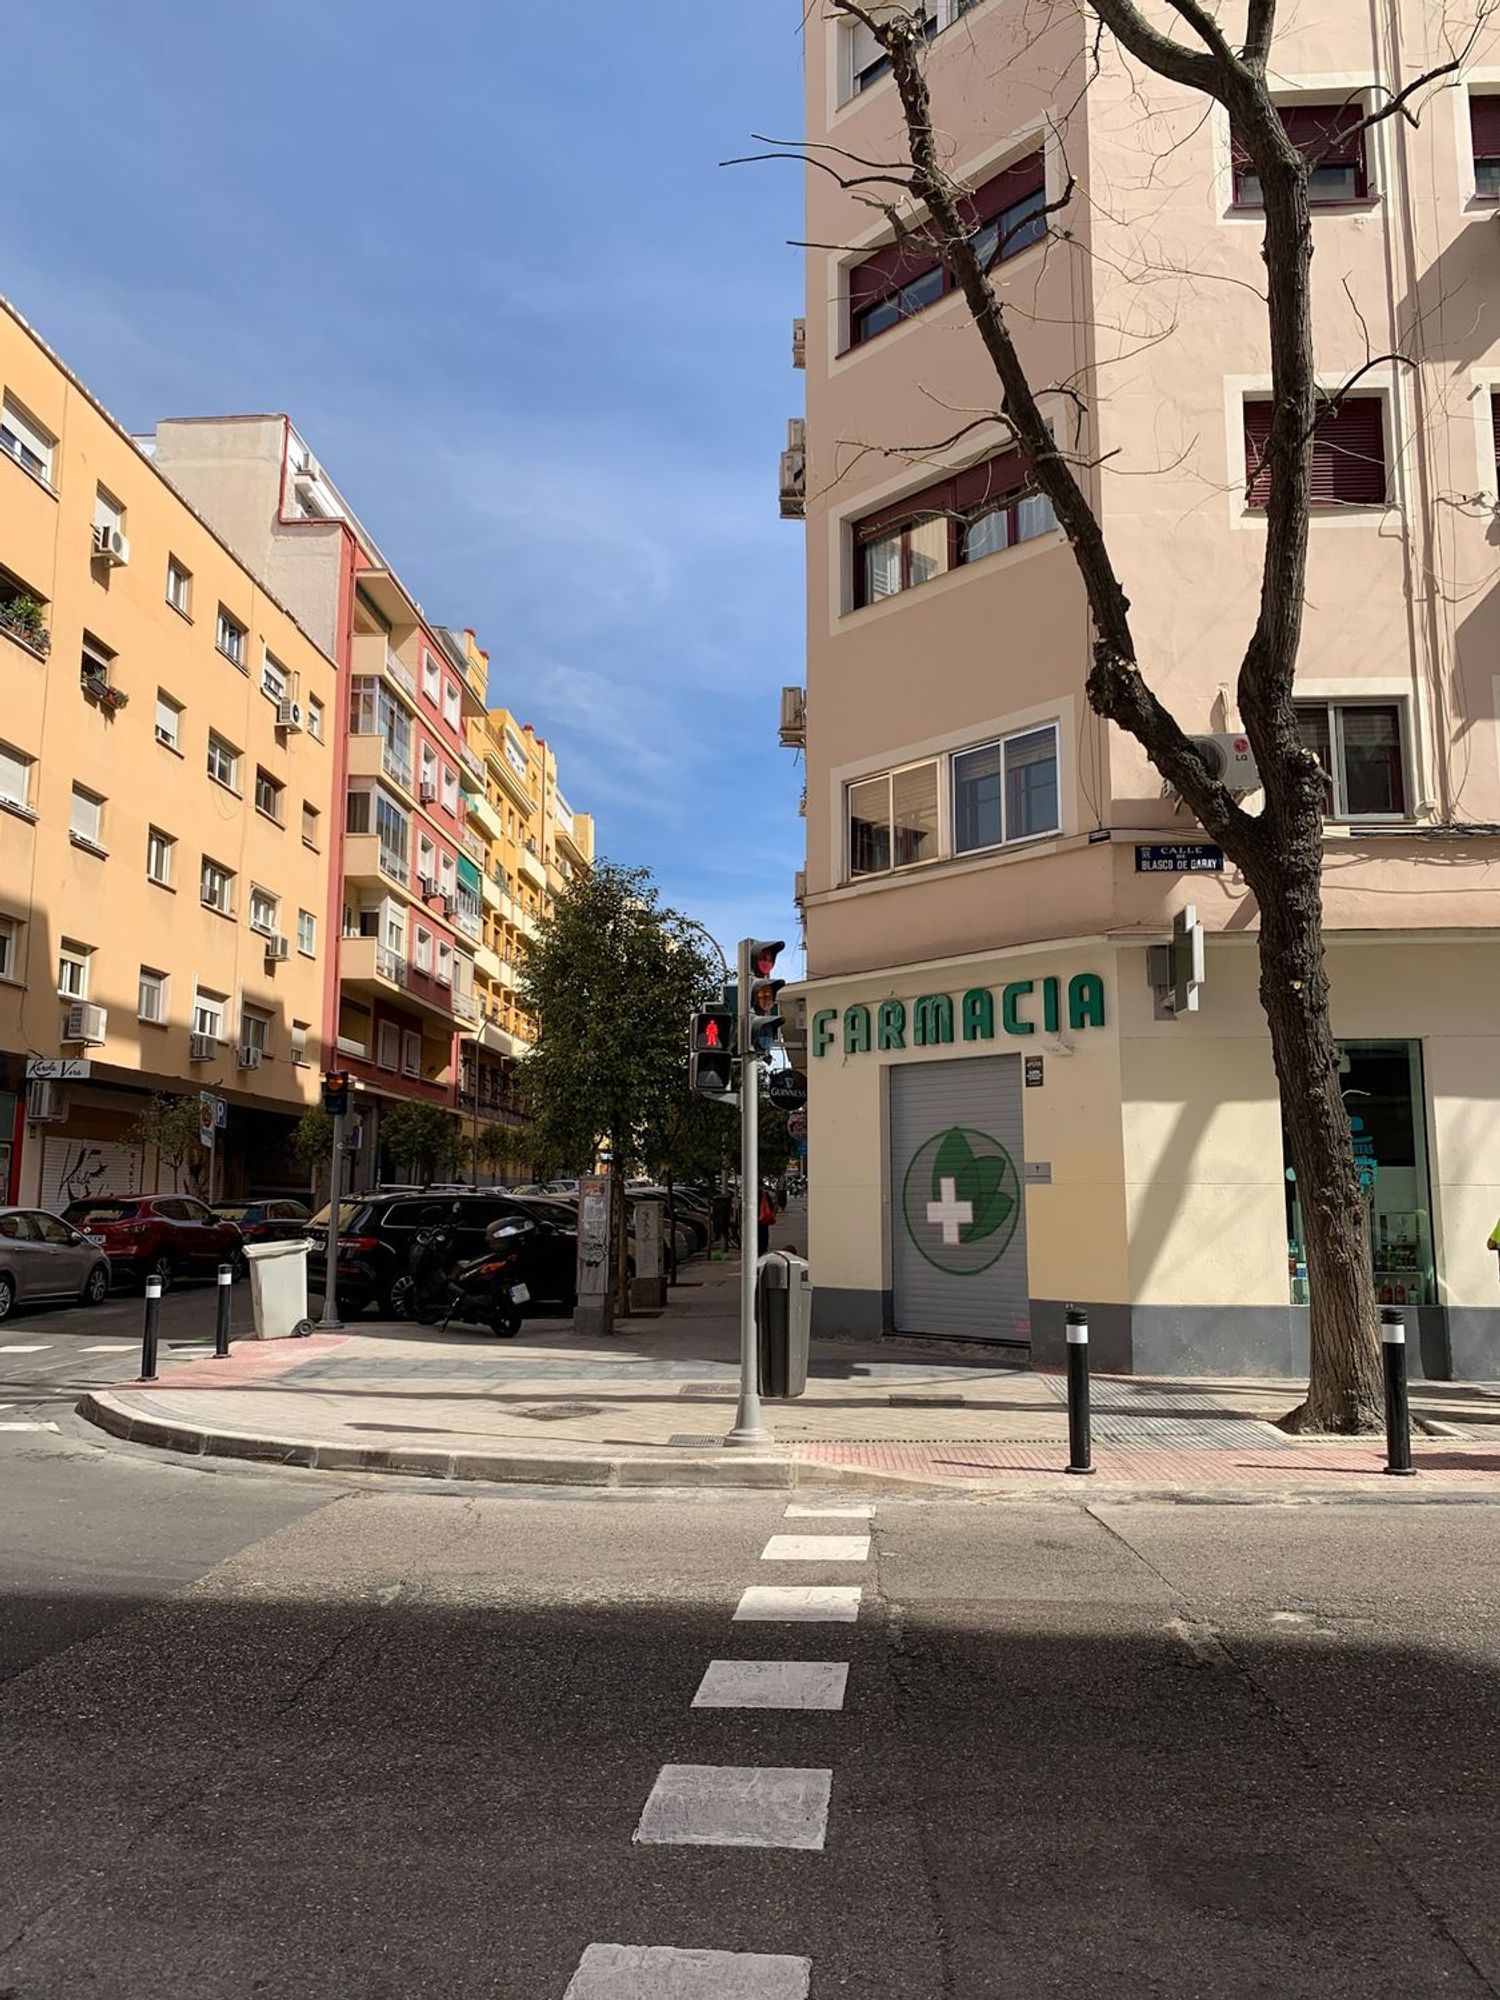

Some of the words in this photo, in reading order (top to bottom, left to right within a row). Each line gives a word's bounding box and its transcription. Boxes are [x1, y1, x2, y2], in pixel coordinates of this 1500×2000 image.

[1160, 847, 1203, 855] CALLE
[1141, 860, 1173, 870] BLASCO
[1177, 860, 1188, 870] DE
[1190, 858, 1217, 869] GARAY
[812, 973, 1105, 1057] FARMACIA
[770, 1086, 806, 1098] GUINNESS
